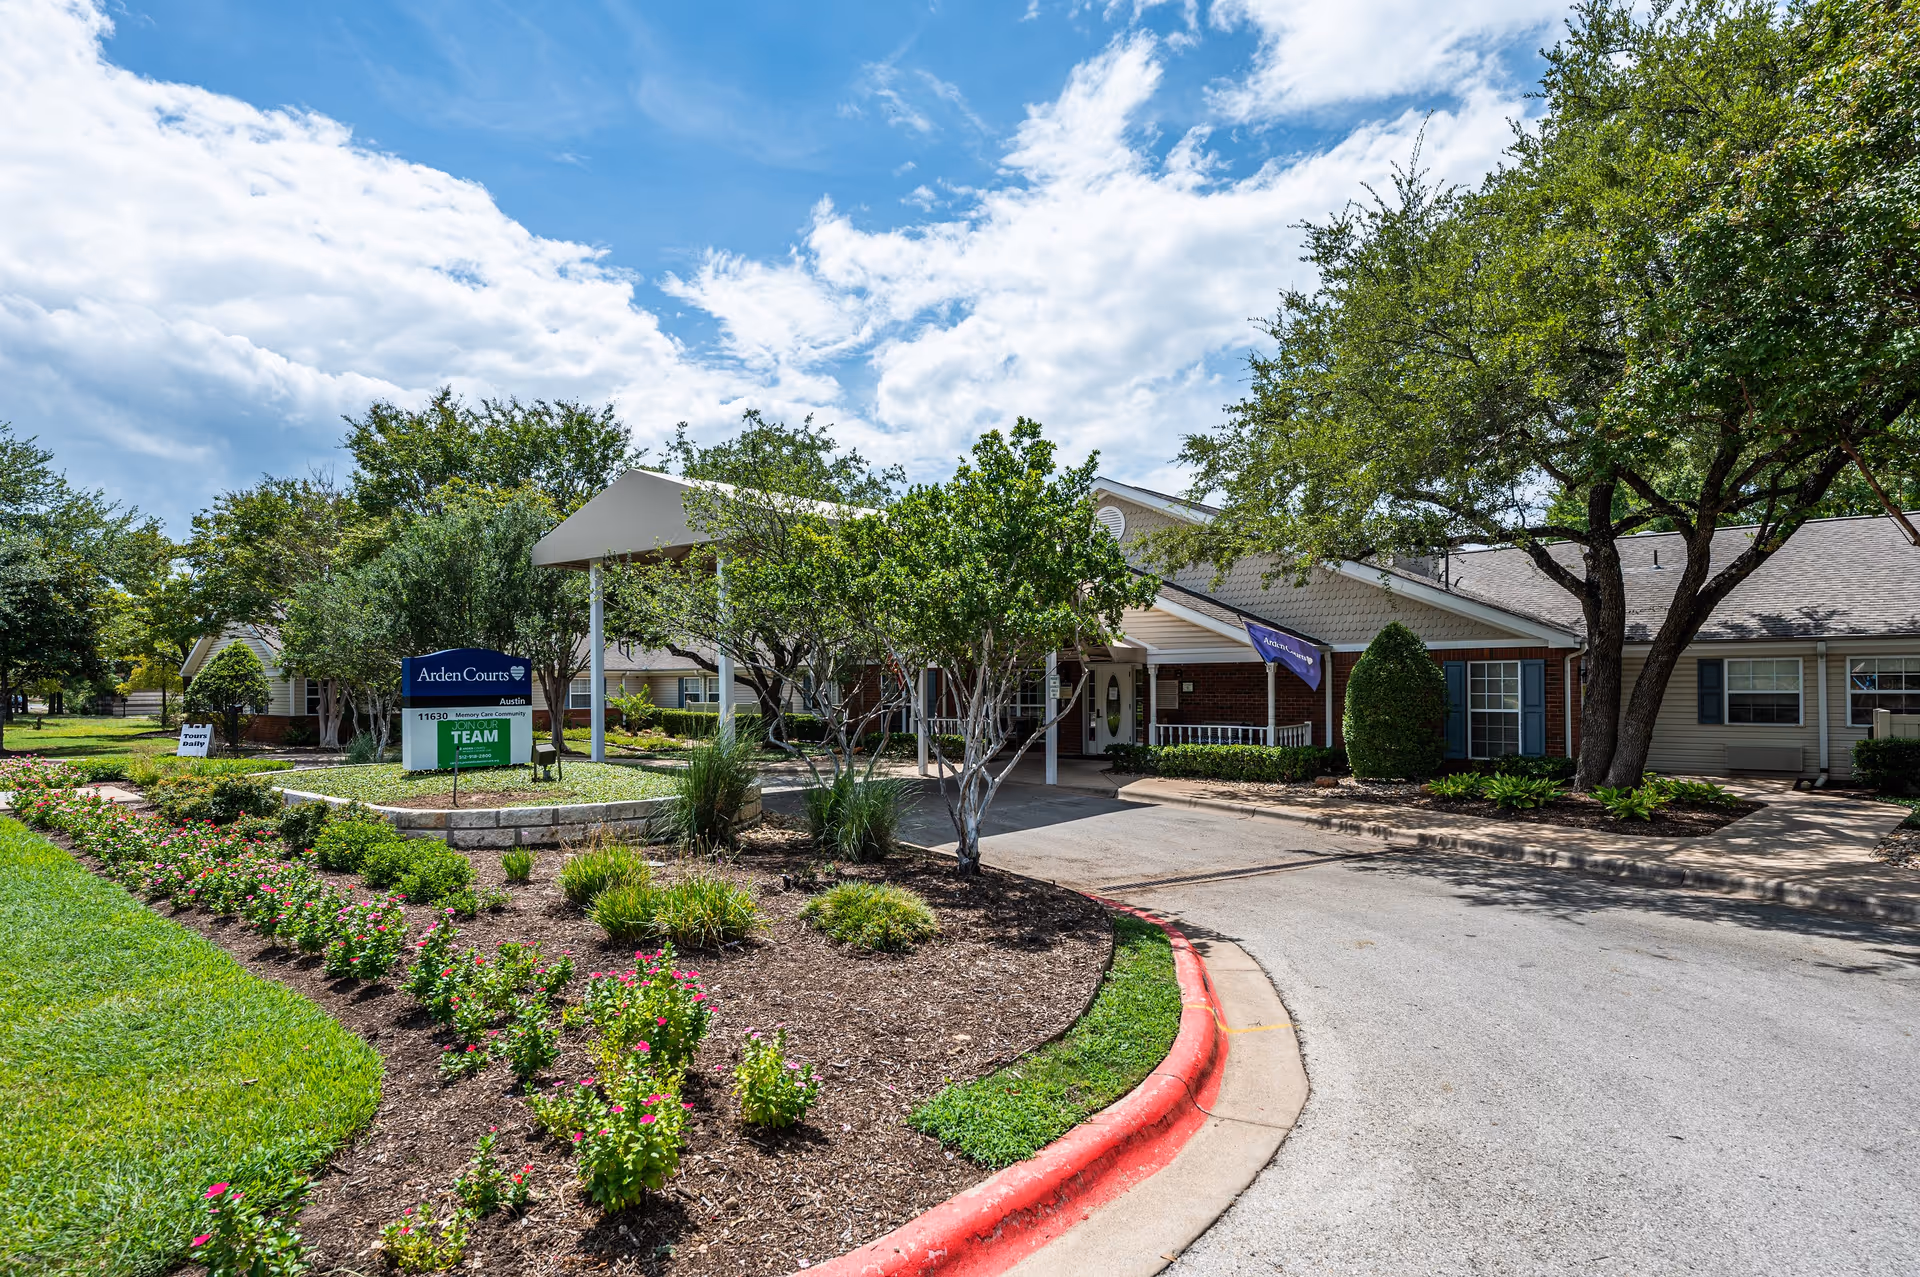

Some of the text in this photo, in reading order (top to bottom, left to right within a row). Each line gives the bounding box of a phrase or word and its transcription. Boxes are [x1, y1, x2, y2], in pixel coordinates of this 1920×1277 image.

[1264, 637, 1286, 650] Arden
[417, 667, 509, 682] Arden Courts
[499, 697, 526, 705] Austin
[418, 712, 448, 721] 11630
[452, 720, 498, 730] JOIN OUR
[451, 730, 498, 744] TEAM
